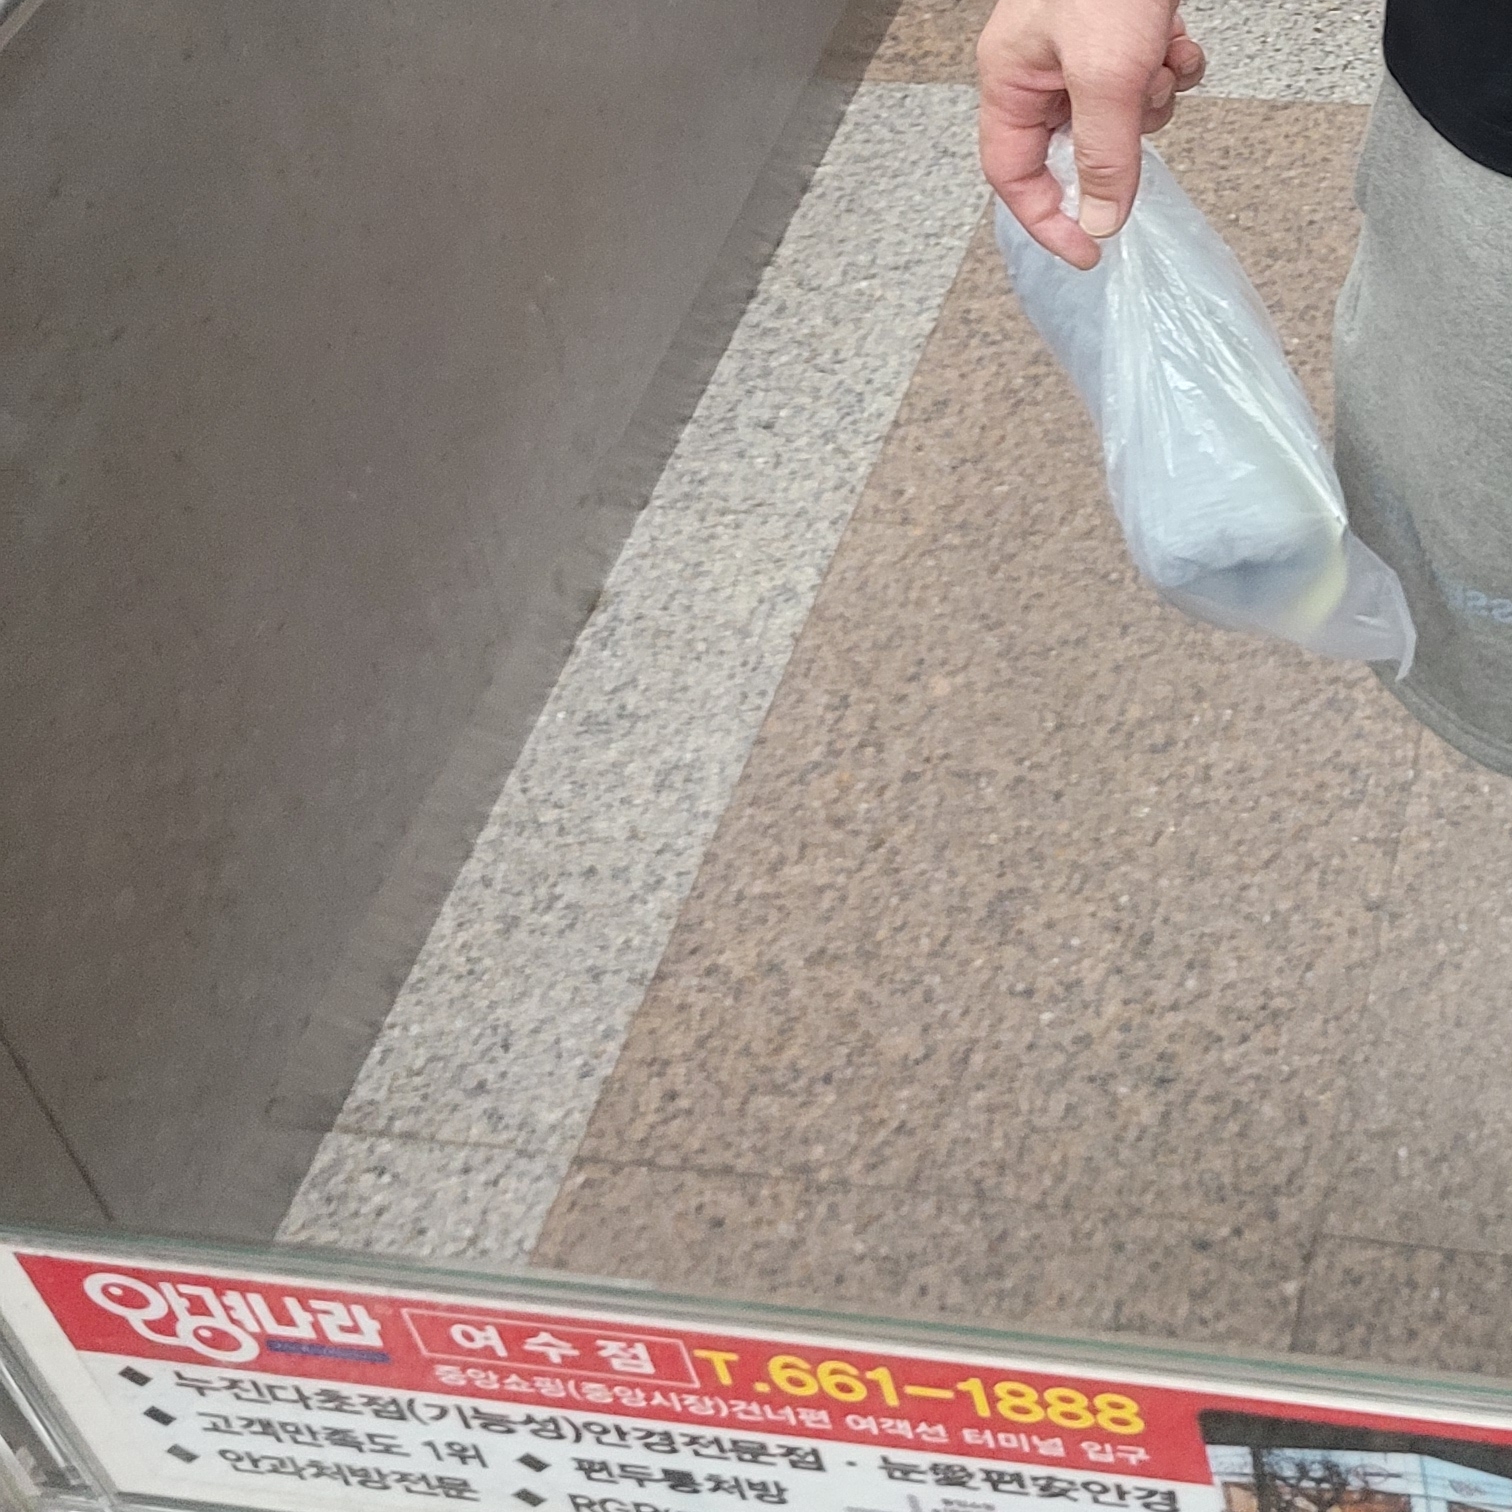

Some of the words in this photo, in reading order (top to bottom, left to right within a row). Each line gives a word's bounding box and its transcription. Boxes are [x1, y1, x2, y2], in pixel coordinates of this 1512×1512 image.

[83, 1272, 385, 1364] 안경나라
[173, 1370, 826, 1472] 누진다초점(기능성)안경전문점
[197, 1411, 411, 1458] 고객만족도
[422, 1439, 489, 1469] 1위
[846, 1413, 949, 1444] 여객선
[962, 1426, 1066, 1458] 터미널
[1081, 1440, 1150, 1467] 입구
[218, 1448, 481, 1502] 안과처방전문
[572, 1456, 789, 1505] 편두통처방
